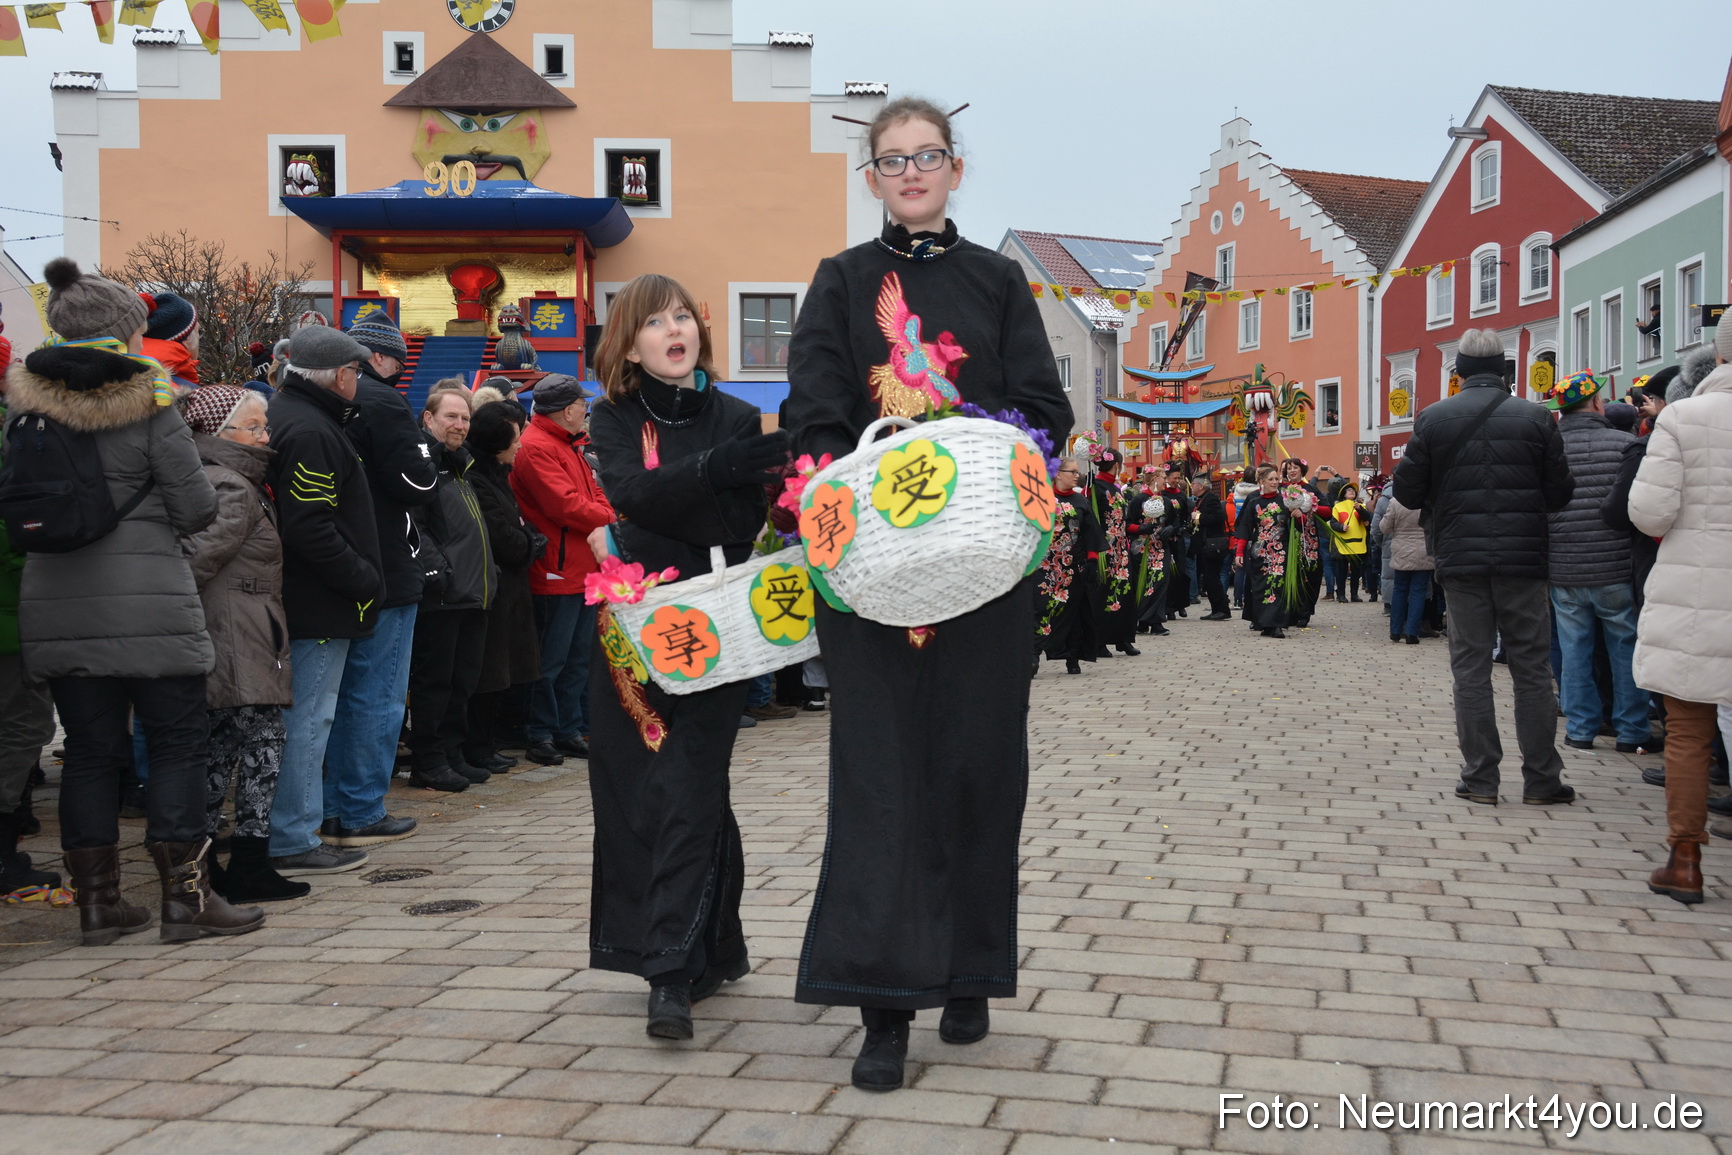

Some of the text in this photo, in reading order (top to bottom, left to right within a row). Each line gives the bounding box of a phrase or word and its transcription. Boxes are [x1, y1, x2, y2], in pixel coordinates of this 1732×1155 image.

[424, 160, 477, 197] 90
[1356, 444, 1378, 455] CAFÉ
[811, 499, 846, 553] 享
[891, 454, 944, 518] 受
[657, 573, 807, 668] 享 受
